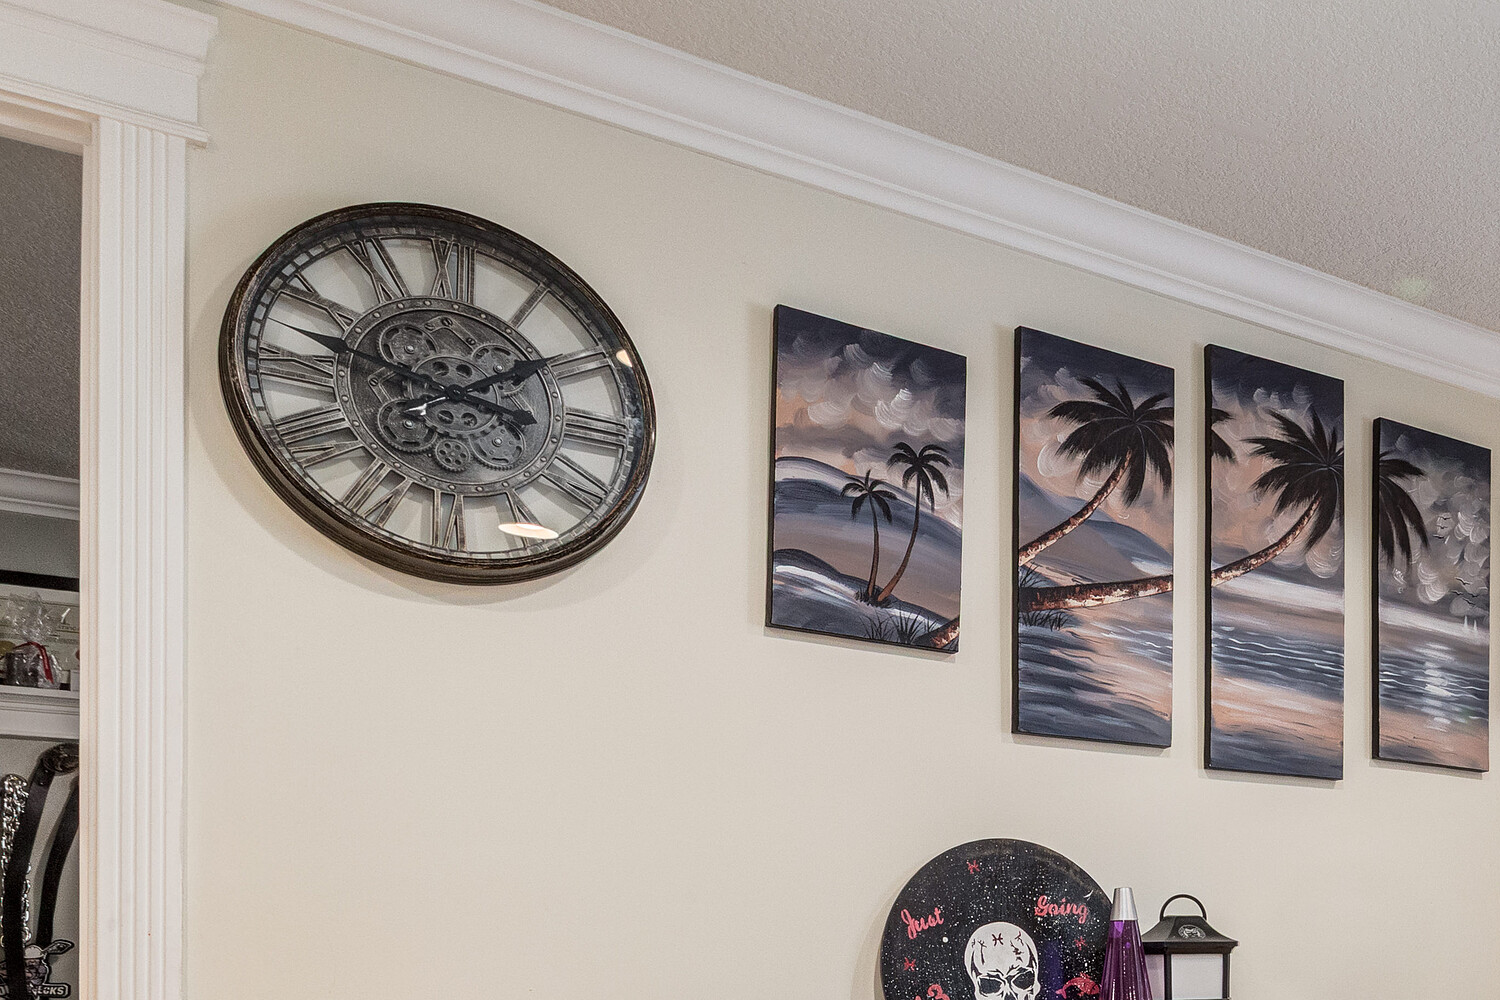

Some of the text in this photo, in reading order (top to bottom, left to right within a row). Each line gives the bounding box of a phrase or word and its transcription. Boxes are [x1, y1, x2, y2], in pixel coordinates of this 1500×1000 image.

[430, 237, 478, 306] XII
[900, 895, 1089, 940] Just Going
